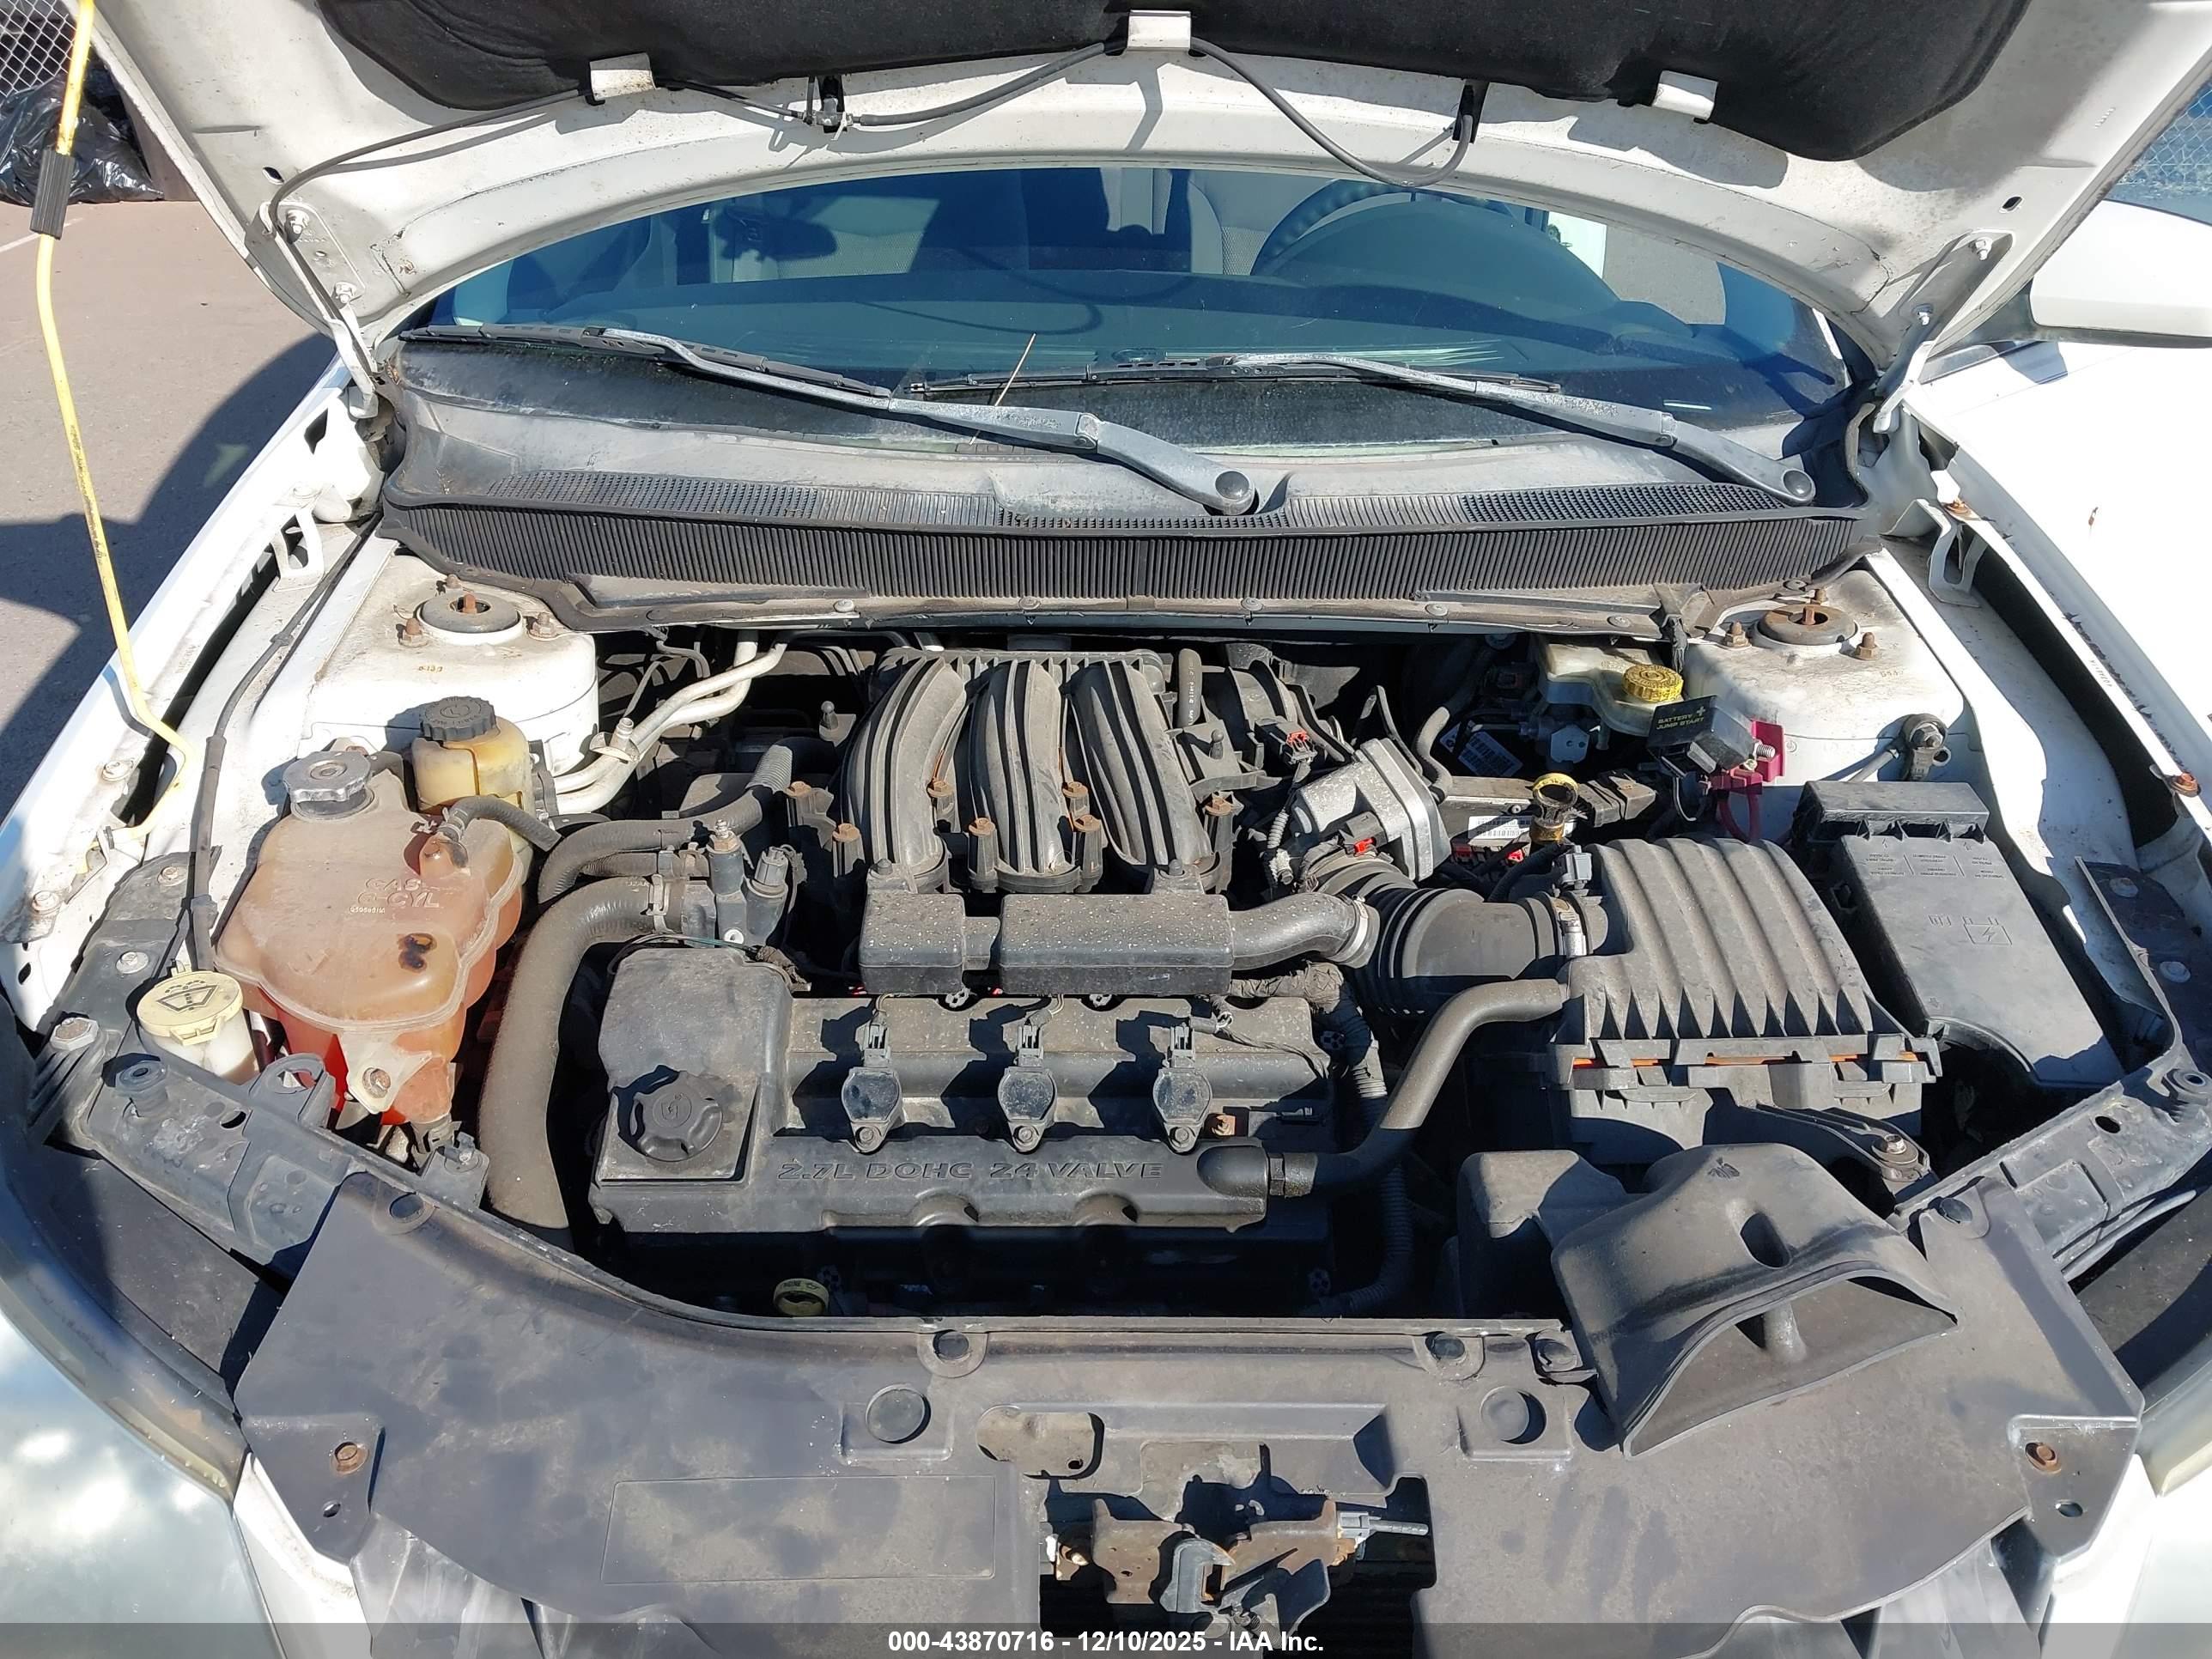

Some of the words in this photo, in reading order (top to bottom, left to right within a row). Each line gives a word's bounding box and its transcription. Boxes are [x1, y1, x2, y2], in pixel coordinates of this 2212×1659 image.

[1658, 714, 1693, 724] BATTERY
[1680, 717, 1705, 726] START
[777, 1162, 855, 1180] 2.7L
[865, 1162, 973, 1180] DOHC
[989, 1162, 1038, 1179] 24
[1047, 1162, 1163, 1179] VALVE
